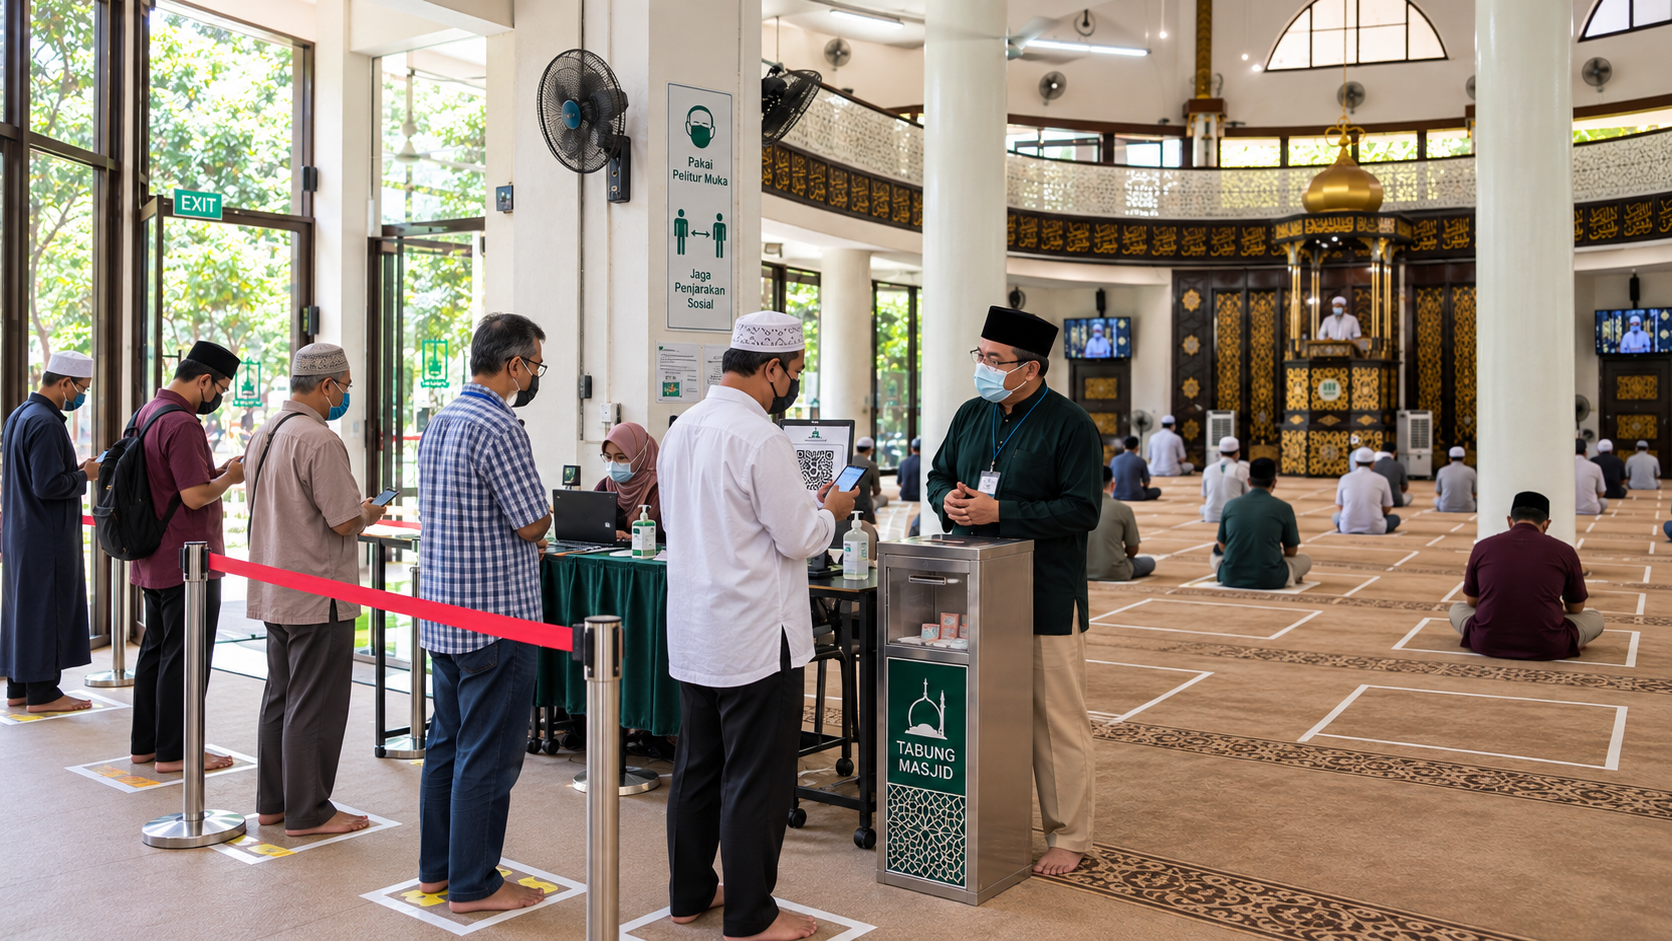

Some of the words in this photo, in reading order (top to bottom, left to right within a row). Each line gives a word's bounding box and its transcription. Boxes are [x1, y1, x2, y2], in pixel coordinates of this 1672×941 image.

[688, 156, 713, 170] Pakai
[704, 173, 728, 187] Muka
[181, 195, 217, 213] EXIT
[690, 268, 711, 282] Jaga
[674, 282, 726, 296] Penjarakan
[687, 297, 714, 310] Sosial
[896, 740, 955, 762] TABUNG
[898, 758, 954, 780] MASJID
